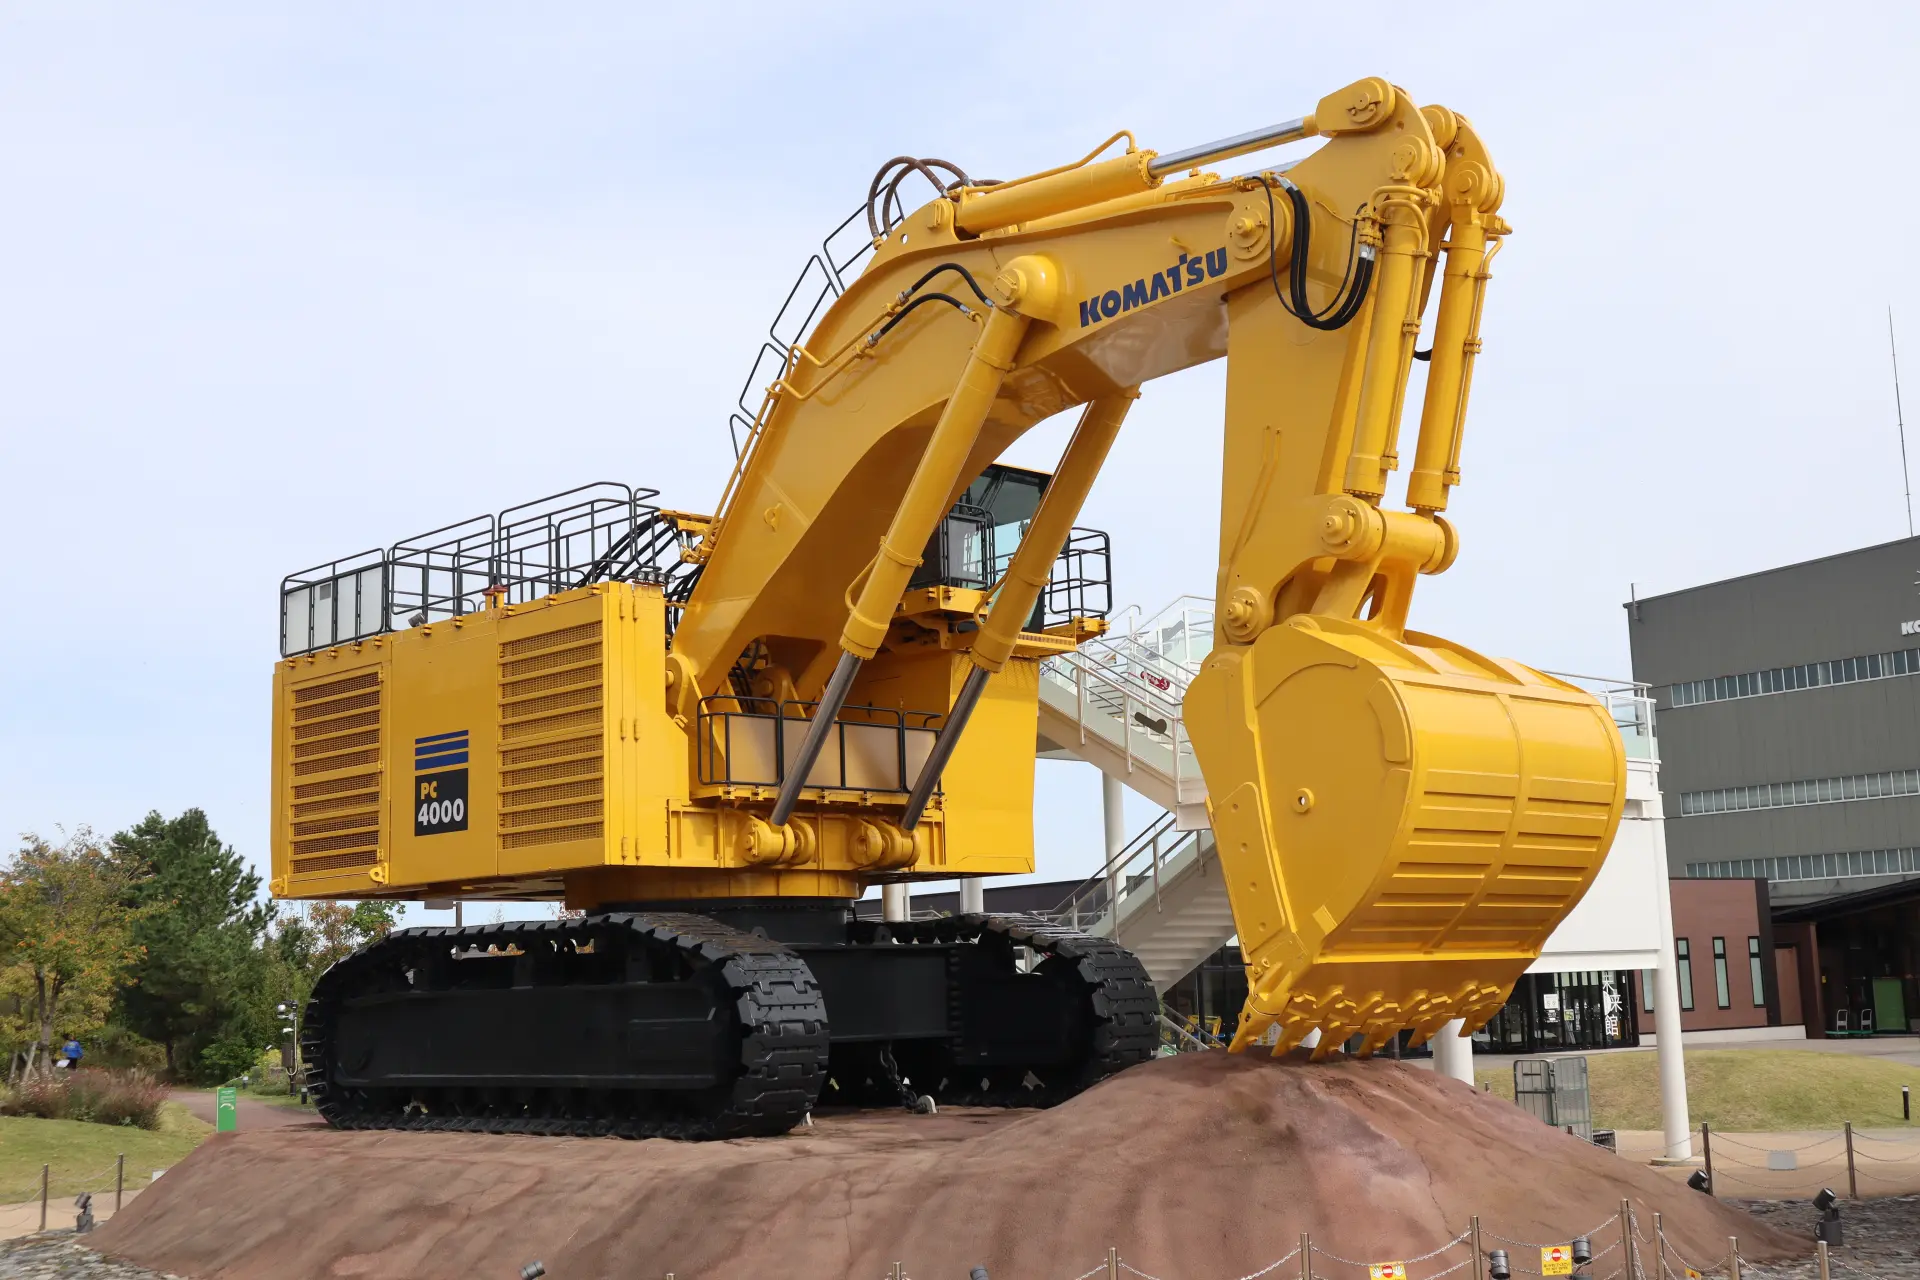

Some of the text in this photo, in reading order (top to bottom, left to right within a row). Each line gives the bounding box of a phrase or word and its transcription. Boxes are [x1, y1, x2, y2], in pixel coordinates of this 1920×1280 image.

[1079, 247, 1228, 328] KOMATSU
[421, 781, 438, 800] PC
[418, 798, 464, 826] 4000
